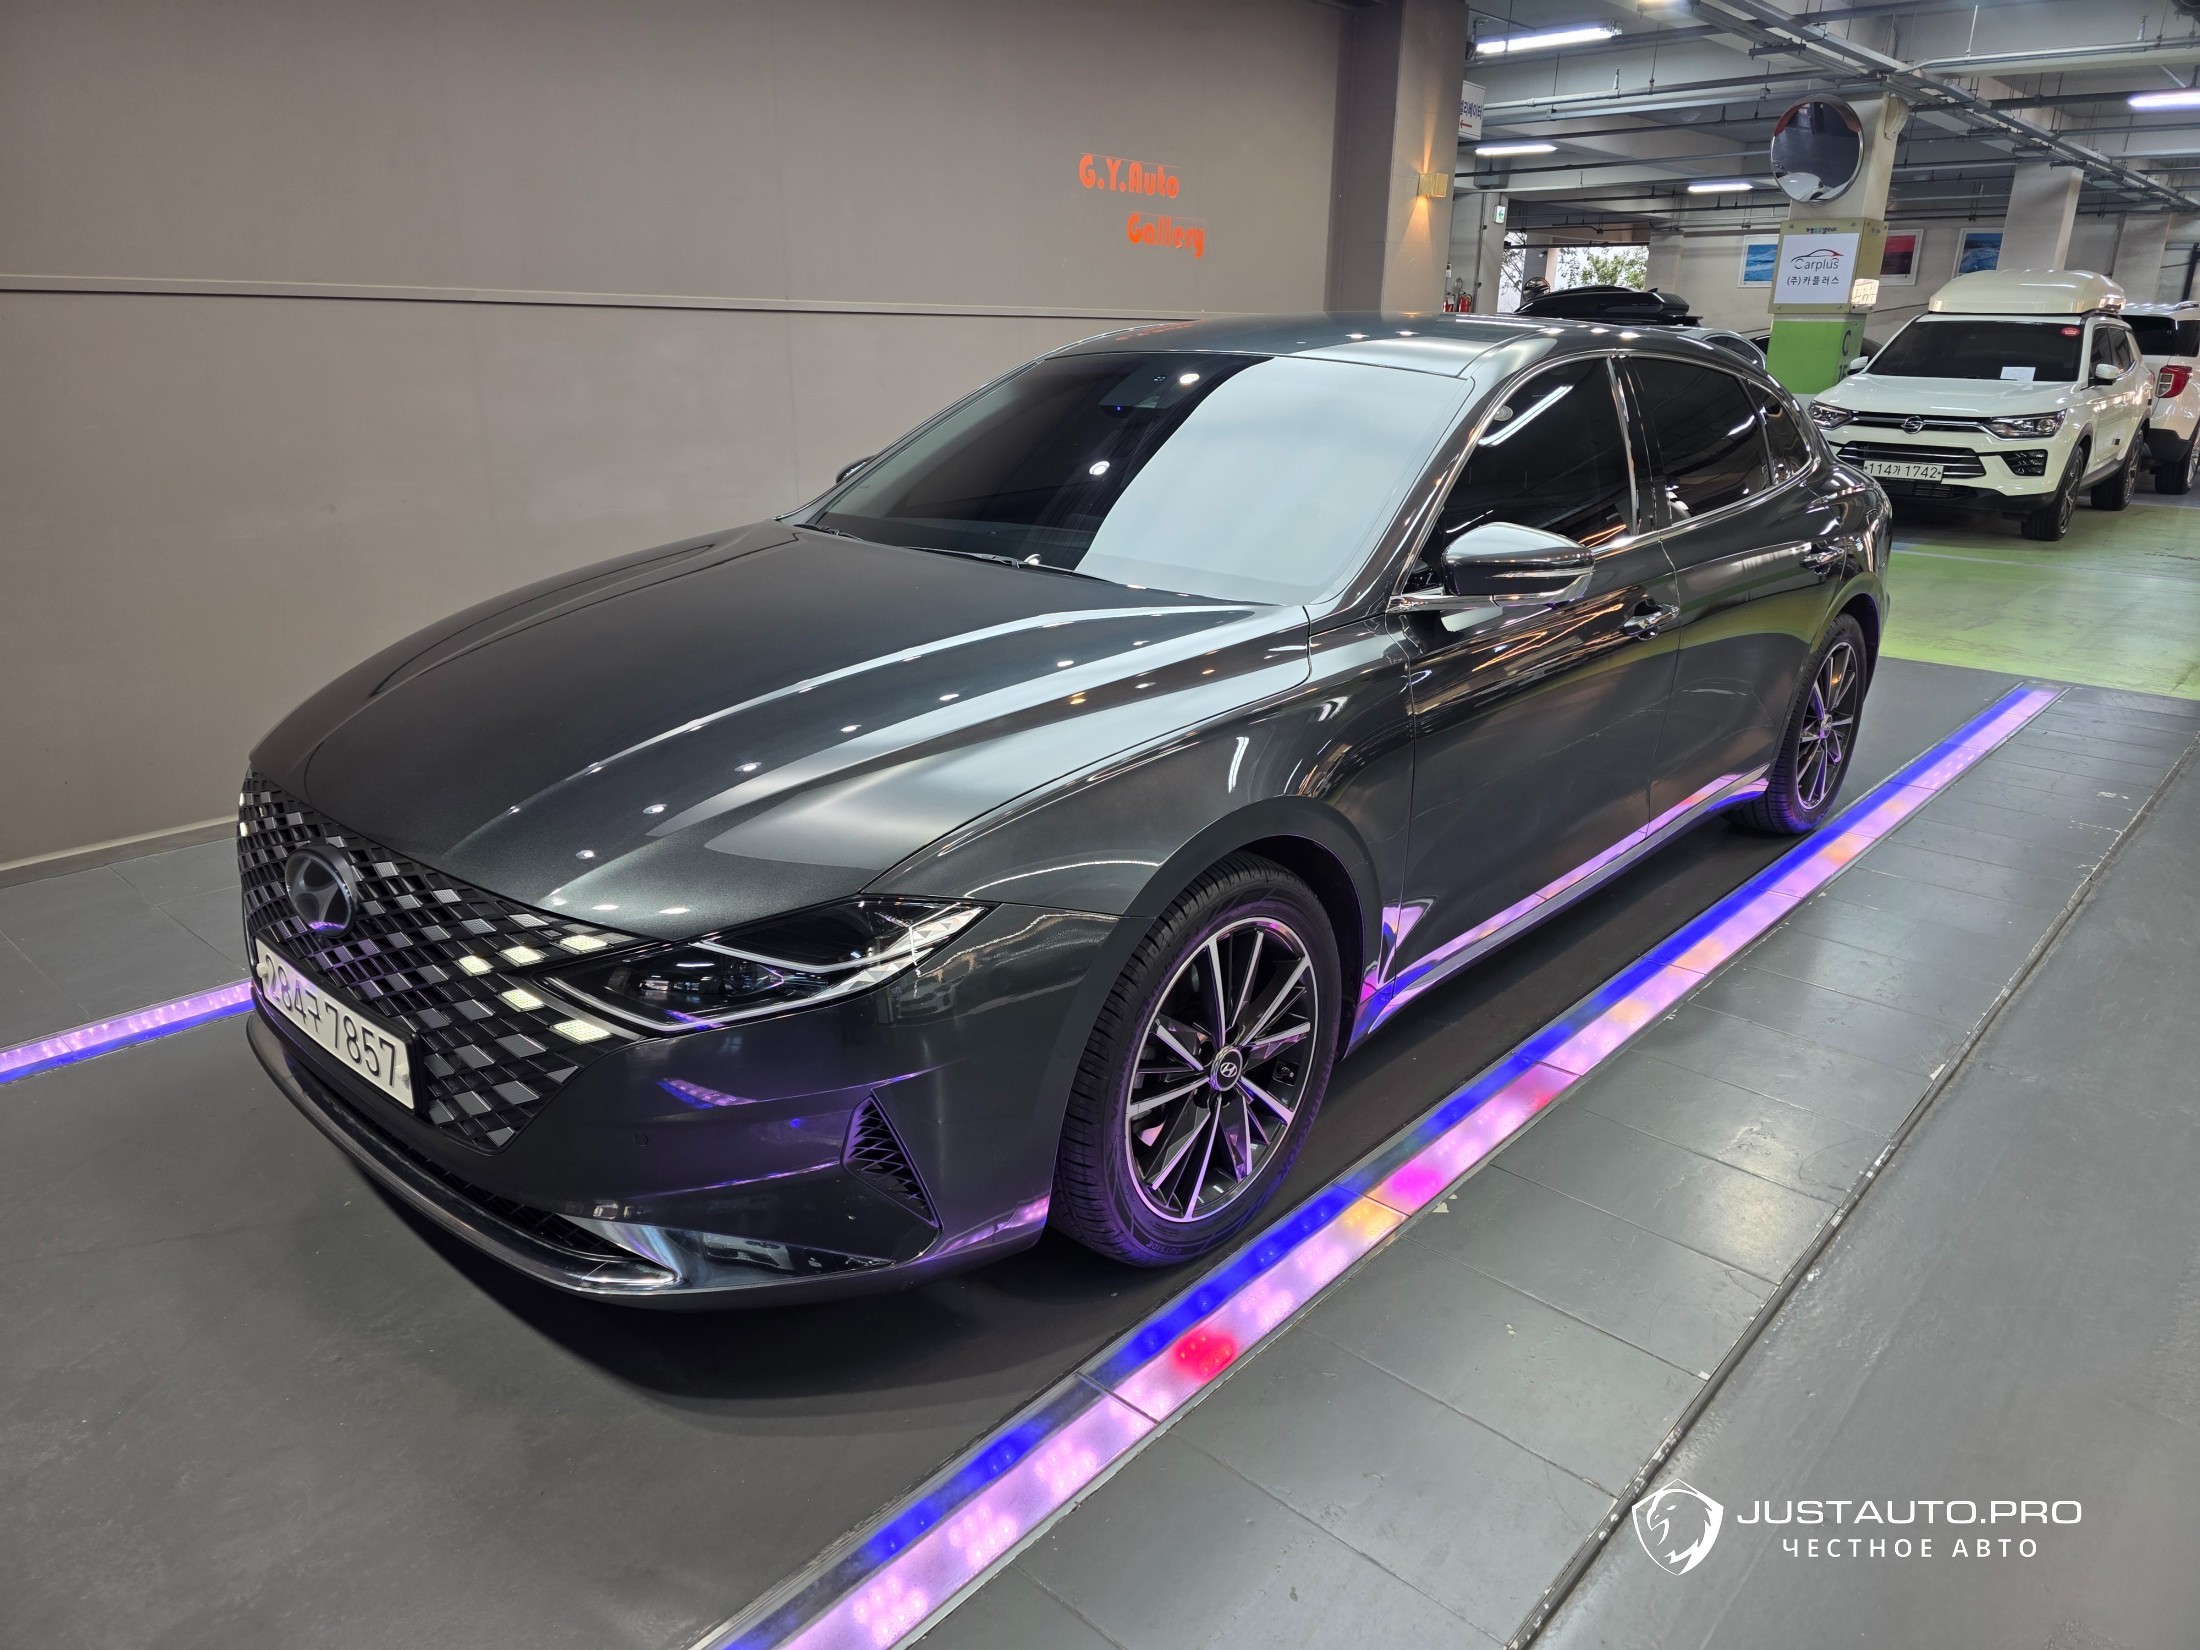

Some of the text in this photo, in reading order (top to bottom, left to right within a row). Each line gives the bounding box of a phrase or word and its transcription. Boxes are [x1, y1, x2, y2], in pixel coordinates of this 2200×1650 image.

[1079, 153, 1180, 199] G.Y.Auto
[1126, 211, 1205, 259] Gallery
[1794, 257, 1840, 272] Carplus
[1842, 329, 1852, 357] C
[1869, 462, 1938, 479] 114가 1742
[265, 954, 397, 1087] 284구 7857
[1145, 1239, 1184, 1256] OUTSIDE
